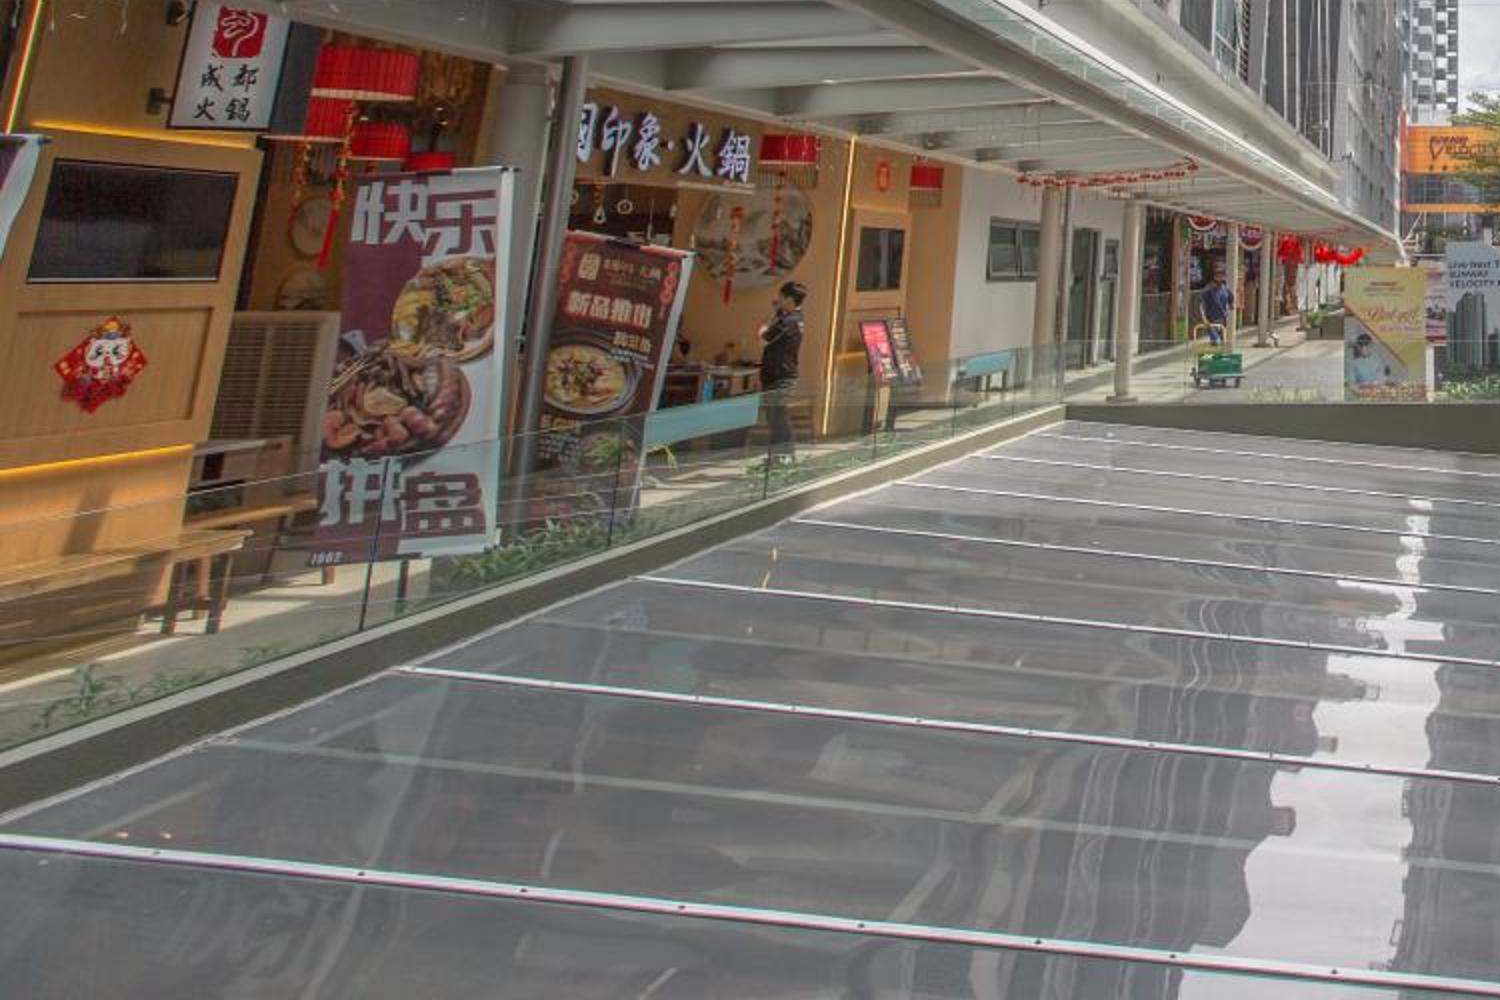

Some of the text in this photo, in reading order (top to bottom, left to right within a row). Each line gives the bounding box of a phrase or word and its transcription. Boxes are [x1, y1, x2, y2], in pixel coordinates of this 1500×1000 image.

[201, 63, 259, 92] 成都
[351, 179, 497, 258] 快乐
[1449, 279, 1494, 289] VELOCITY
[319, 457, 488, 537] 拼盘
